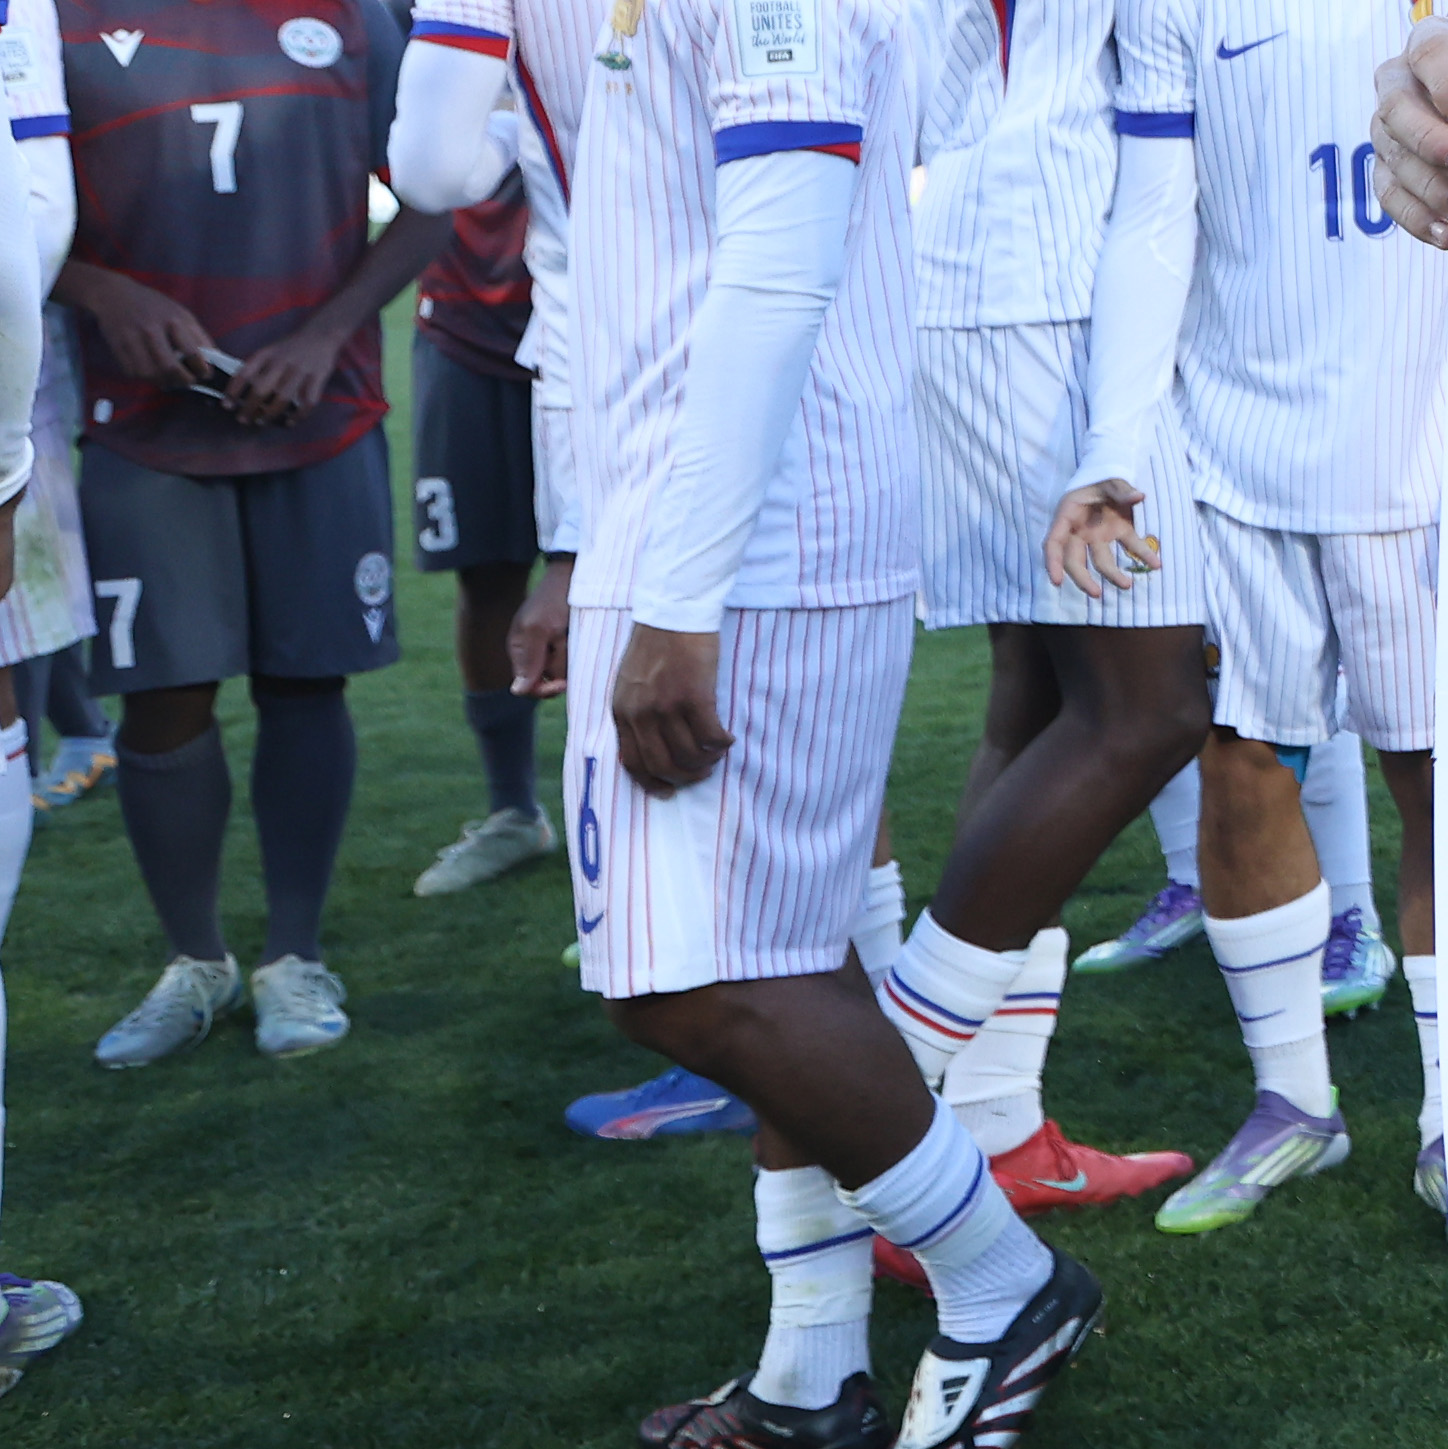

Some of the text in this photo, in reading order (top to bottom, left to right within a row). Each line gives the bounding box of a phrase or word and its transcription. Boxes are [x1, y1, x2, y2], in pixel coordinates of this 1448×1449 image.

[750, 0, 801, 13] FOOTBALL
[751, 13, 803, 32] UNITES
[190, 101, 244, 194] 7
[1309, 143, 1397, 241] 10
[415, 477, 459, 552] 3
[95, 578, 143, 669] 7
[580, 756, 600, 888] 6
